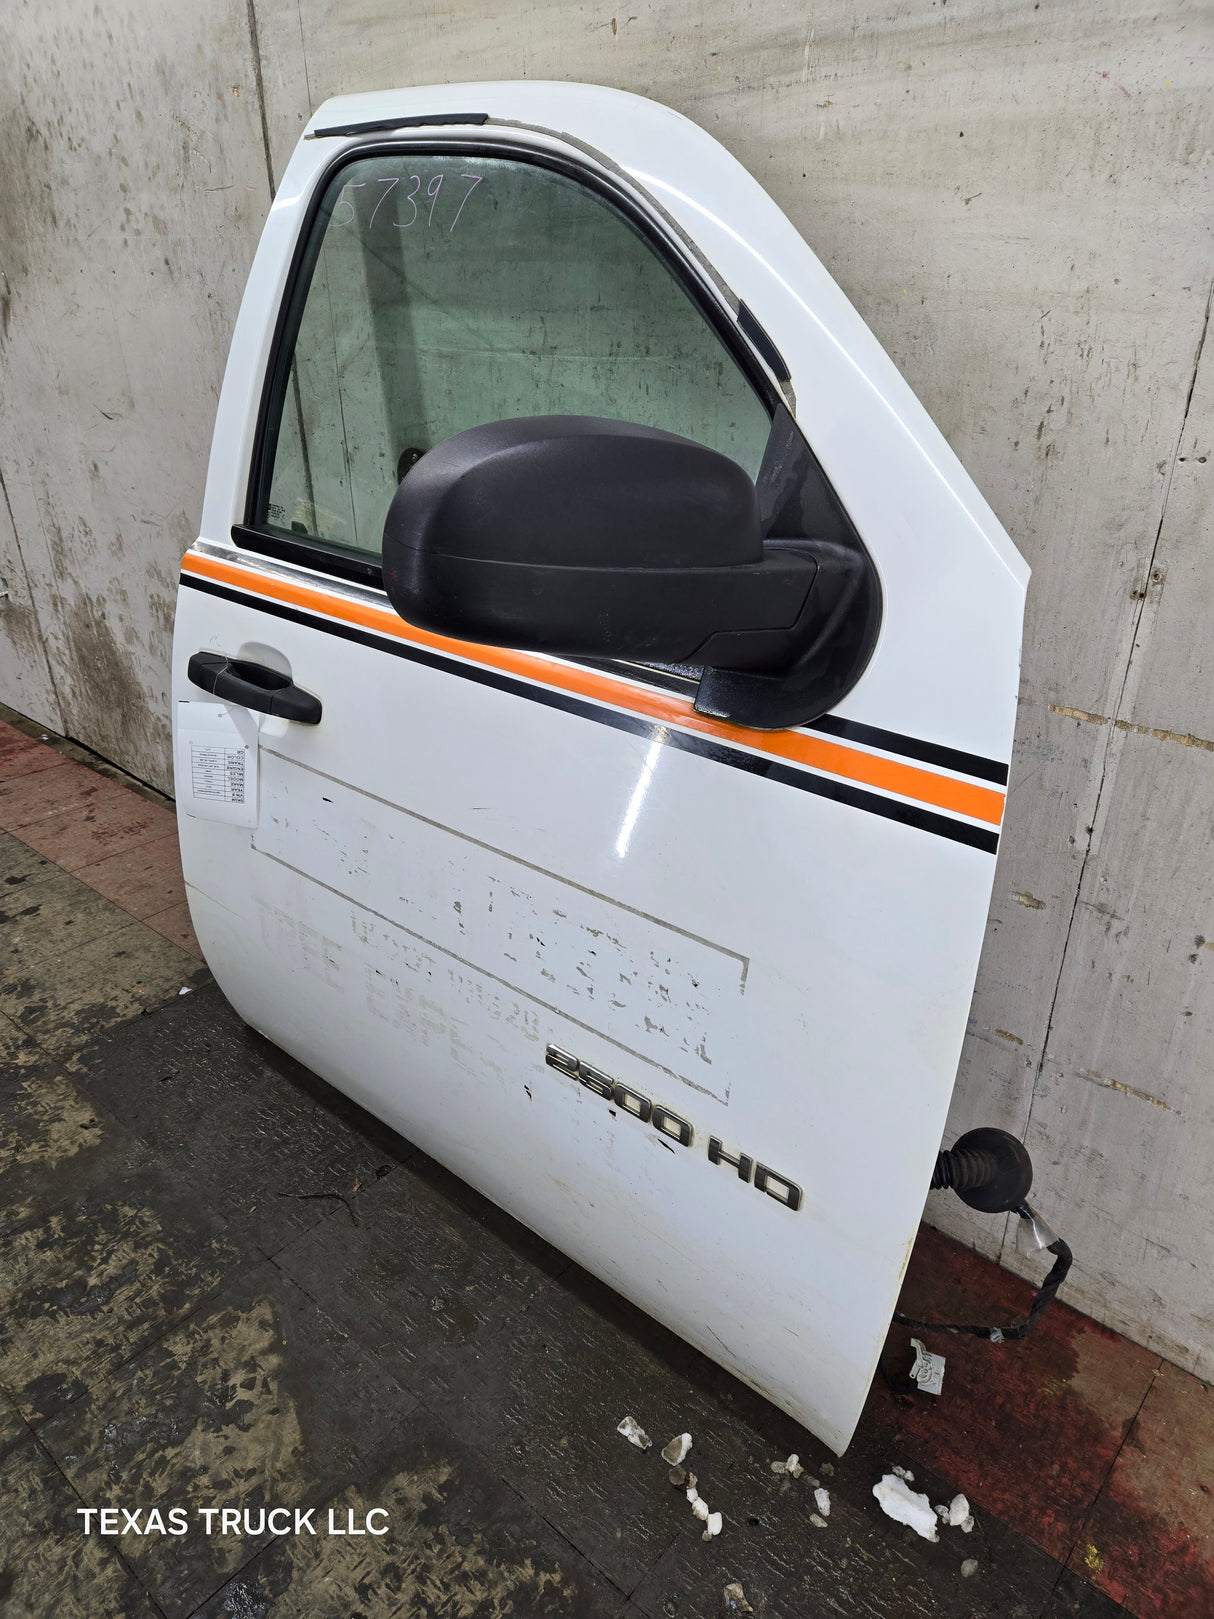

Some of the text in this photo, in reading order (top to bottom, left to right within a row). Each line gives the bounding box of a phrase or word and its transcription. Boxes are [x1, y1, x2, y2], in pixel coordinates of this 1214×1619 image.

[328, 174, 483, 232] 57397
[545, 1043, 803, 1211] 2500 HD
